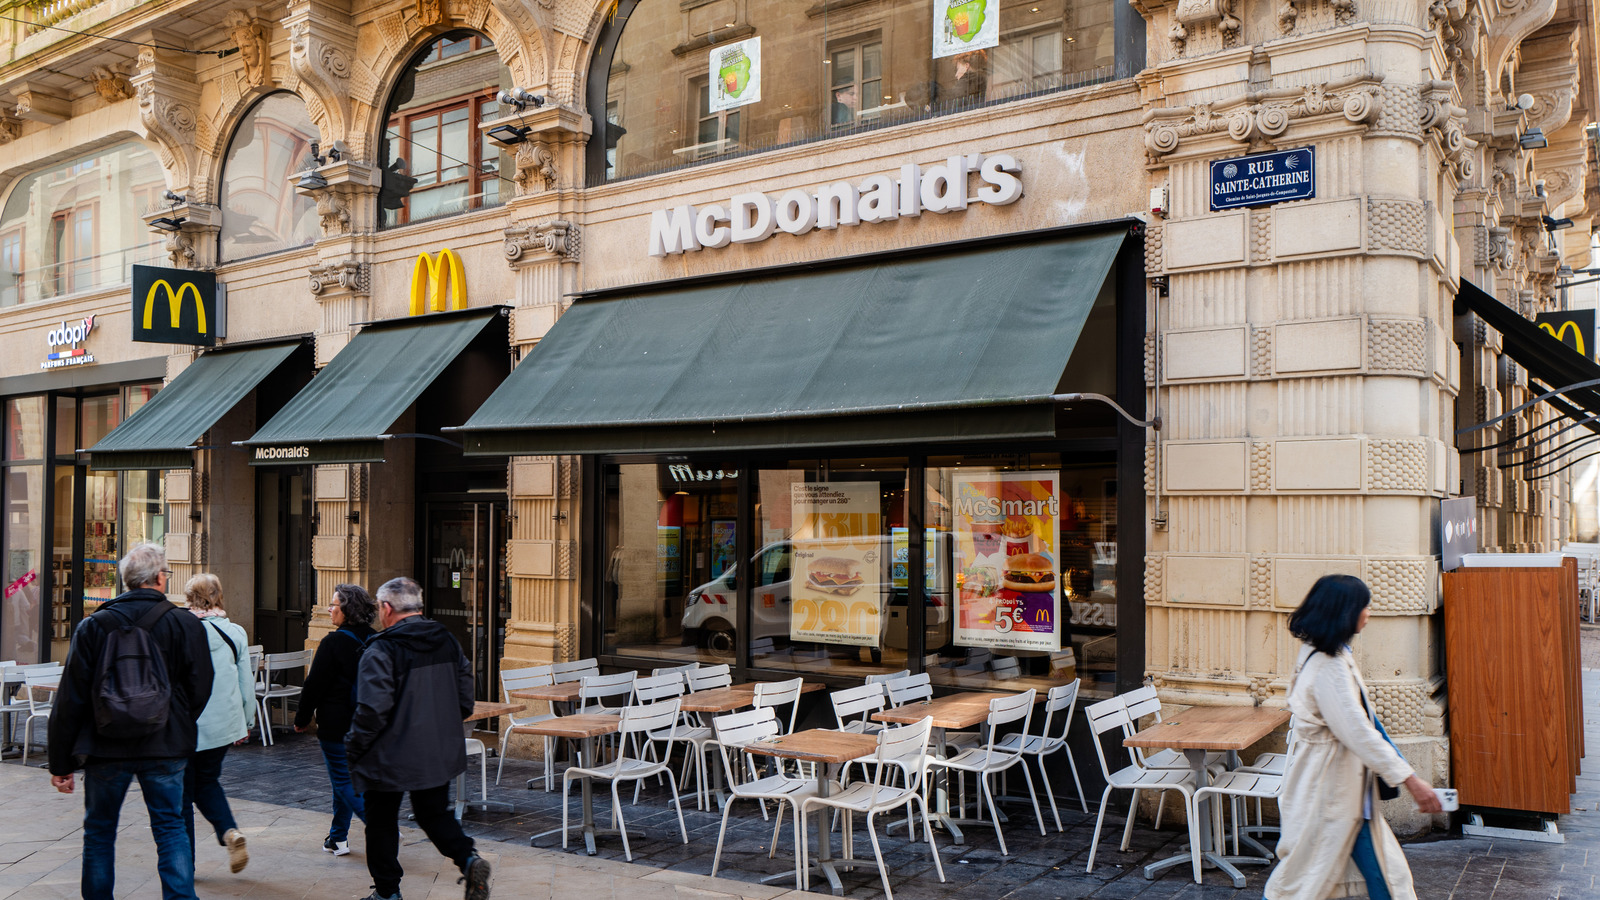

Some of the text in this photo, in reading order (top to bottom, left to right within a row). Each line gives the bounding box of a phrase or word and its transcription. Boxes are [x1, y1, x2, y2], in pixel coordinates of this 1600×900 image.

[1248, 160, 1274, 175] RUE
[1215, 170, 1309, 195] SAINTE-CATHERINE
[649, 153, 1023, 257] McDonald's
[48, 319, 87, 349] adopt
[41, 355, 94, 369] PARFUMS FRANÇAIS
[255, 446, 310, 459] McDonald's
[954, 496, 1058, 516] McSmart
